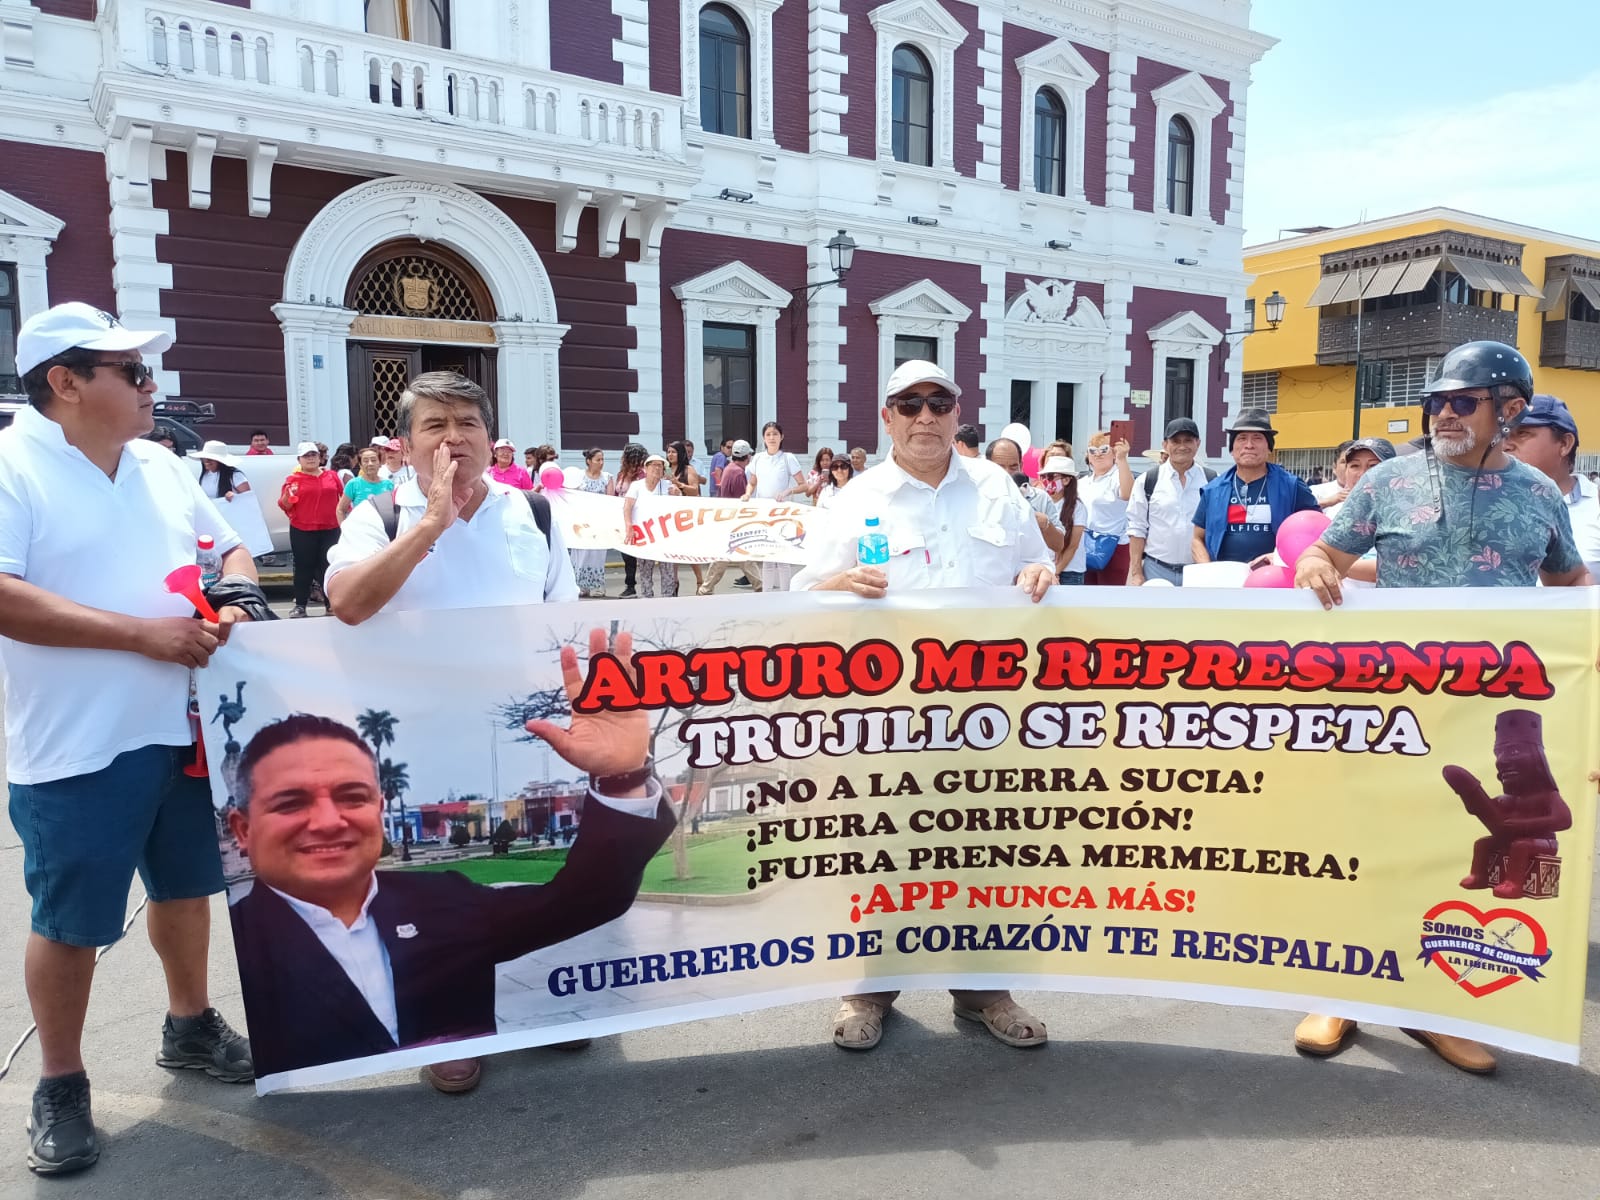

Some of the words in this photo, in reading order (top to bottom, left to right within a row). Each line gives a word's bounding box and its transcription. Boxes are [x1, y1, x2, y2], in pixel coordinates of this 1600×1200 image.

[1230, 524, 1270, 532] LFIGE
[572, 638, 904, 714] ARTURO
[910, 638, 1027, 694] ME
[1033, 637, 1555, 700] REPRESENTA
[679, 703, 1012, 768] TRUJILLO
[1017, 701, 1106, 750] SE
[1114, 701, 1431, 756] RESPETA
[746, 778, 818, 815] ¡NO
[827, 775, 859, 800] A
[868, 771, 923, 797] LA
[933, 768, 1110, 794] GUERRA
[1119, 768, 1265, 794] SUCIA!
[746, 811, 899, 853] ¡FUERA
[908, 800, 1194, 833] CORRUPCIÓN!
[747, 849, 899, 890] ¡FUERA
[907, 844, 1072, 871] PRENSA
[1080, 844, 1361, 882] MERMELERA!
[850, 880, 959, 924] ¡APP
[966, 885, 1098, 910] NUNCA
[1105, 881, 1197, 914] MÁS!
[1422, 920, 1485, 939] SOMOS
[1424, 938, 1482, 952] GUERREROS
[1483, 946, 1496, 957] DE
[1496, 950, 1542, 967] CORAZÓN
[547, 935, 816, 998] GUERREROS
[826, 929, 884, 961] DE
[895, 913, 1093, 954] CORAZÓN
[1103, 926, 1159, 957] TE
[1170, 929, 1406, 983] RESPALDA
[1448, 956, 1461, 966] LA
[1463, 958, 1519, 976] LIBERTAD
